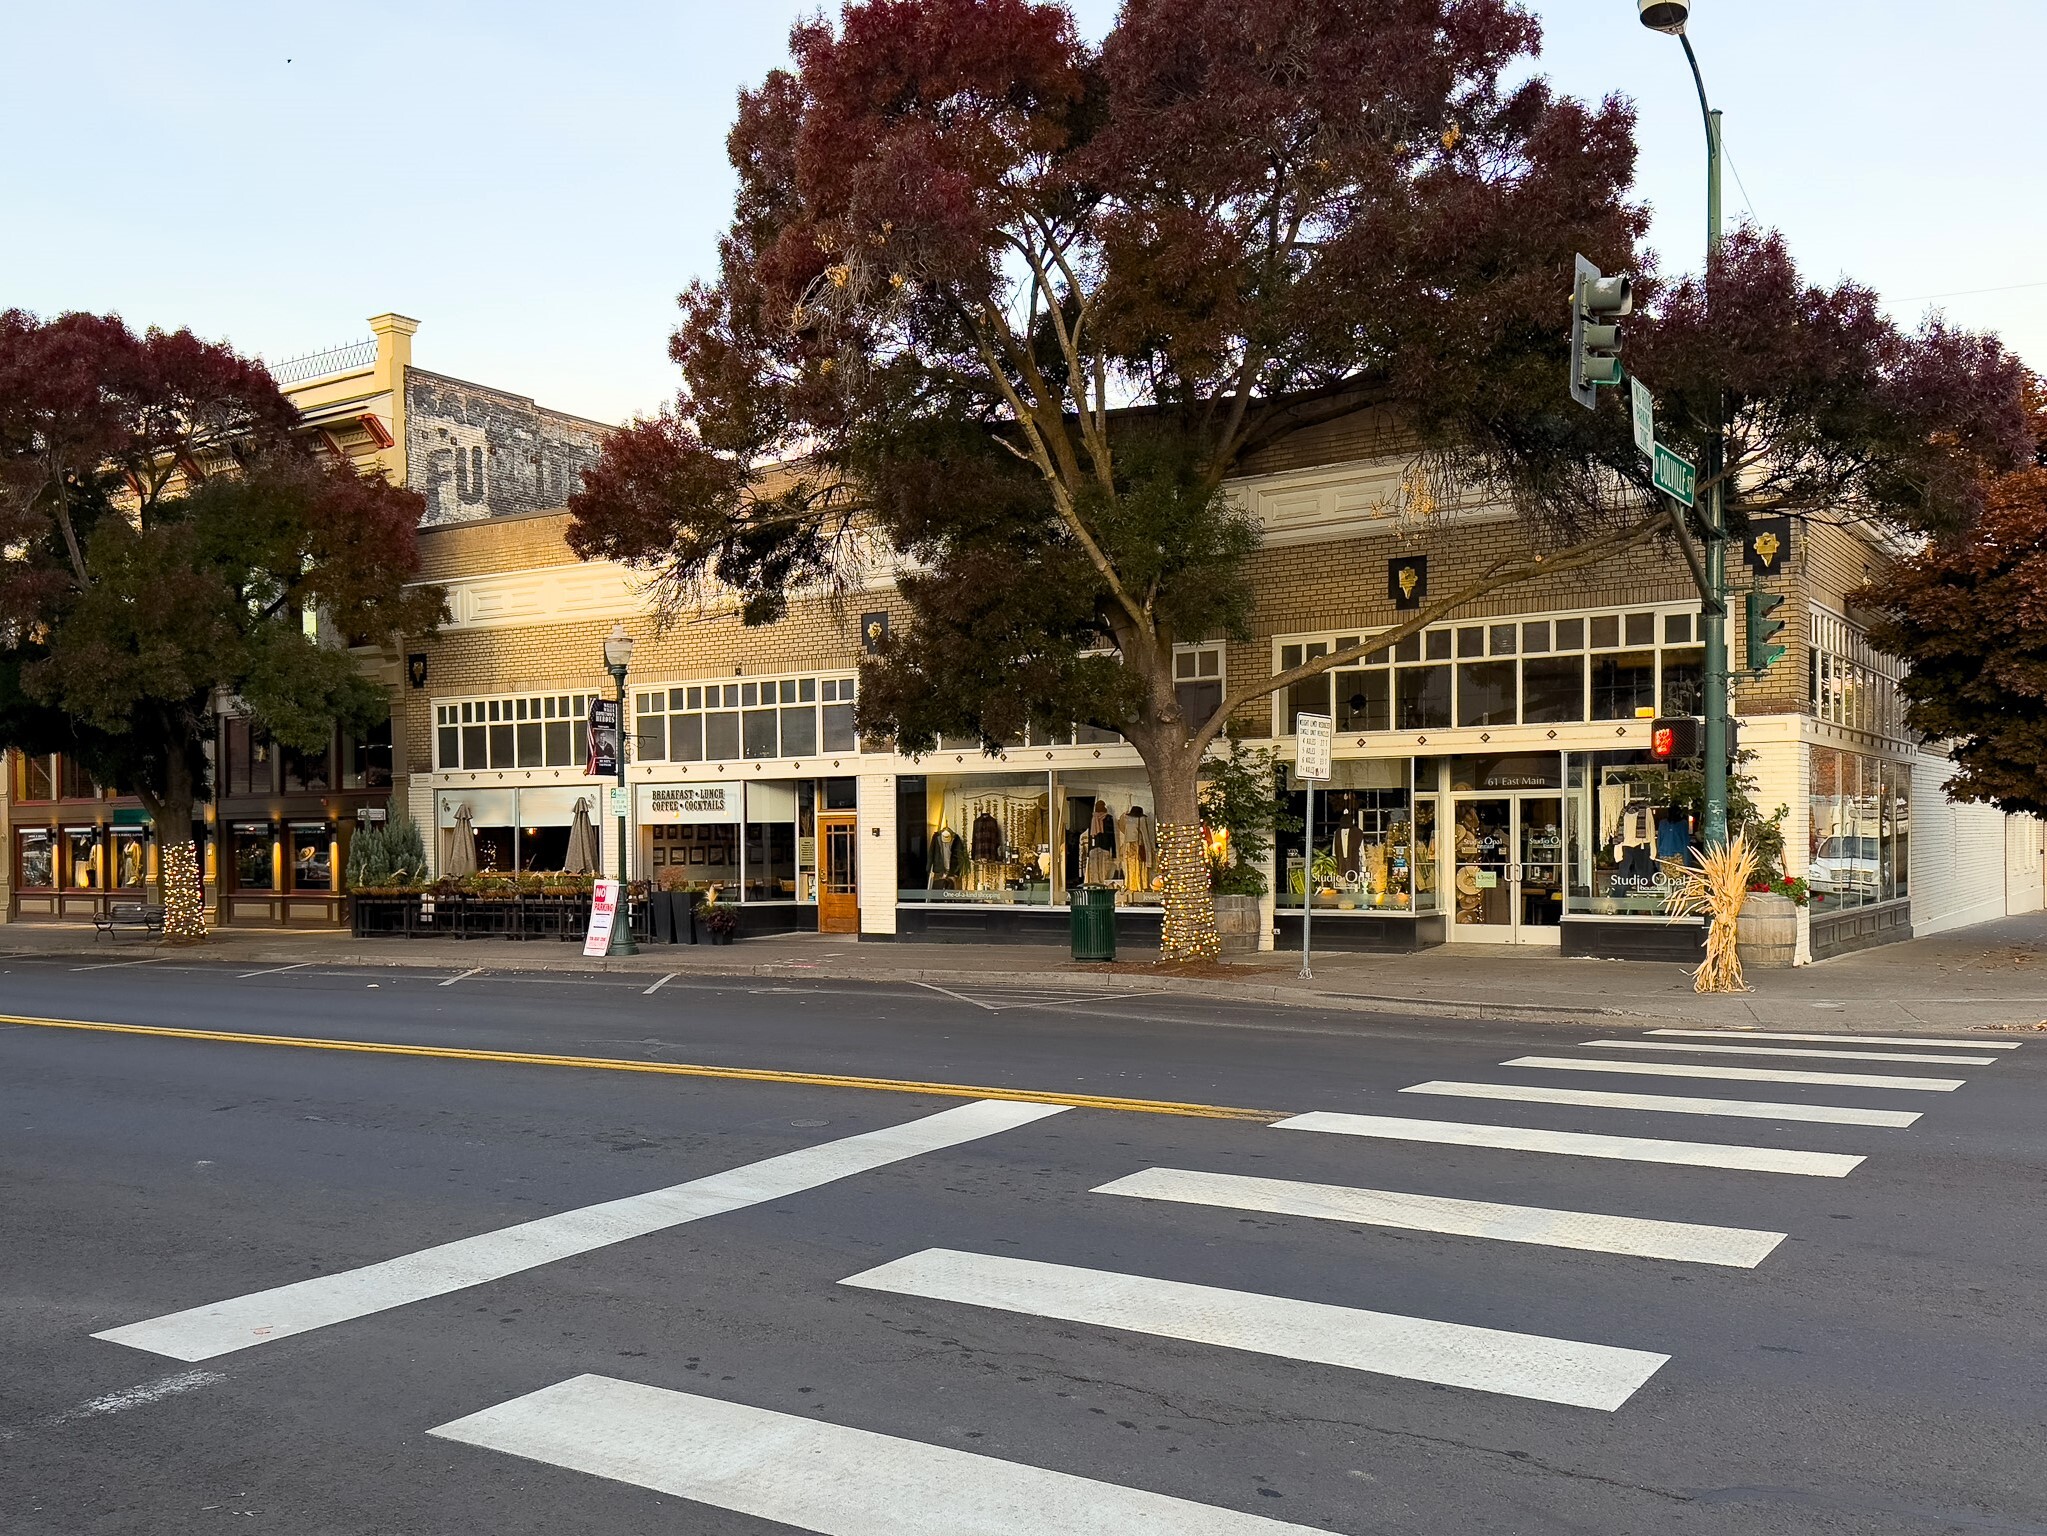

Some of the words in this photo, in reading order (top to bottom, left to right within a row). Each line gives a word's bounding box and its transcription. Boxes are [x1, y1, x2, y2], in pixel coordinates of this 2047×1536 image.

[1660, 453, 1686, 496] COLVILLE
[1687, 474, 1693, 494] ST
[1487, 778, 1499, 786] 61
[1502, 777, 1520, 786] East
[1521, 777, 1546, 785] Main
[652, 789, 695, 800] BREAKFAST
[700, 788, 726, 800] LUNCH
[652, 801, 679, 812] COFFEE
[684, 799, 726, 812] COCKTAILS
[1311, 871, 1343, 883] Studio
[1610, 873, 1649, 886] Studio
[1651, 871, 1688, 889] Opal
[596, 888, 606, 897] NO
[594, 903, 613, 911] PARKING
